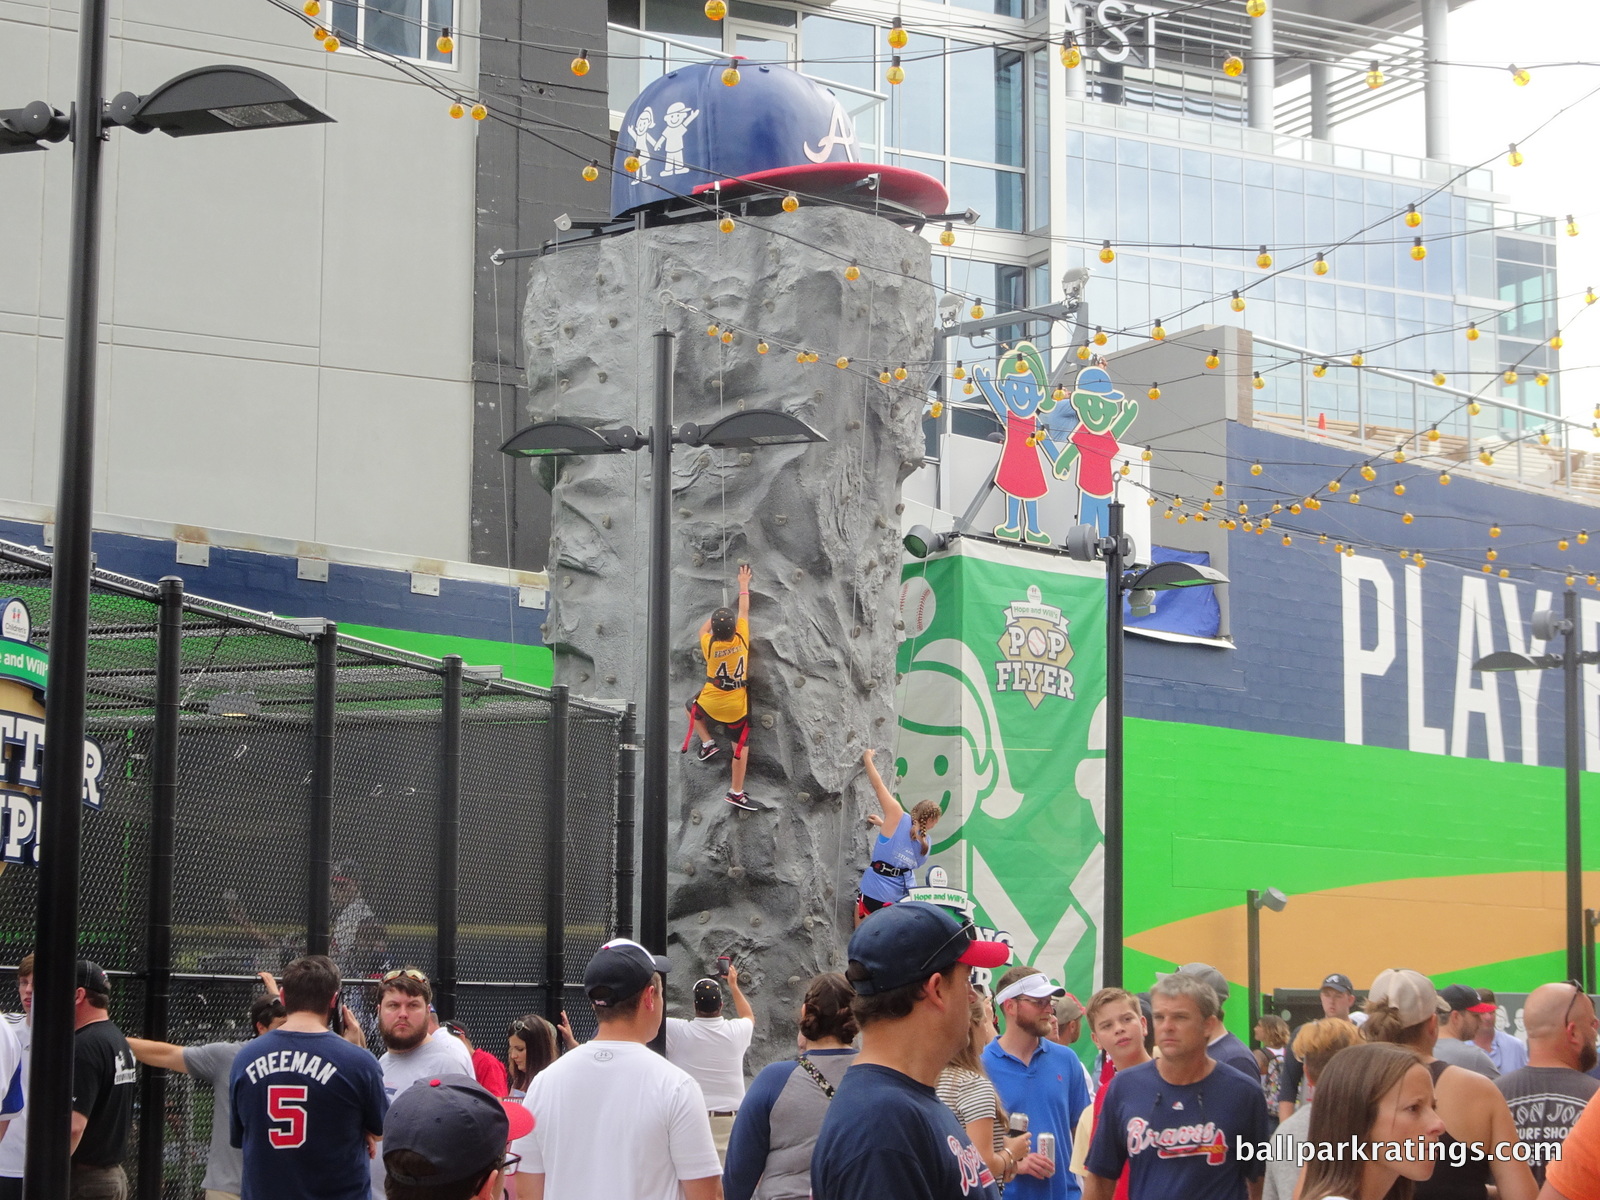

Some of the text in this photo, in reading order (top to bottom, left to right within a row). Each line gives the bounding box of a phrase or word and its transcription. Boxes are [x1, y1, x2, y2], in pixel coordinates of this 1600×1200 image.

[4, 653, 24, 668] and
[1007, 626, 1066, 661] POP
[1341, 552, 1553, 766] PLAY
[715, 655, 745, 680] 44
[995, 661, 1075, 700] FLYER
[914, 892, 965, 904] Hope and Will's
[245, 1050, 338, 1085] FREEMAN
[267, 1084, 308, 1149] 5
[1516, 1127, 1542, 1140] URF
[1126, 1116, 1215, 1157] Braves
